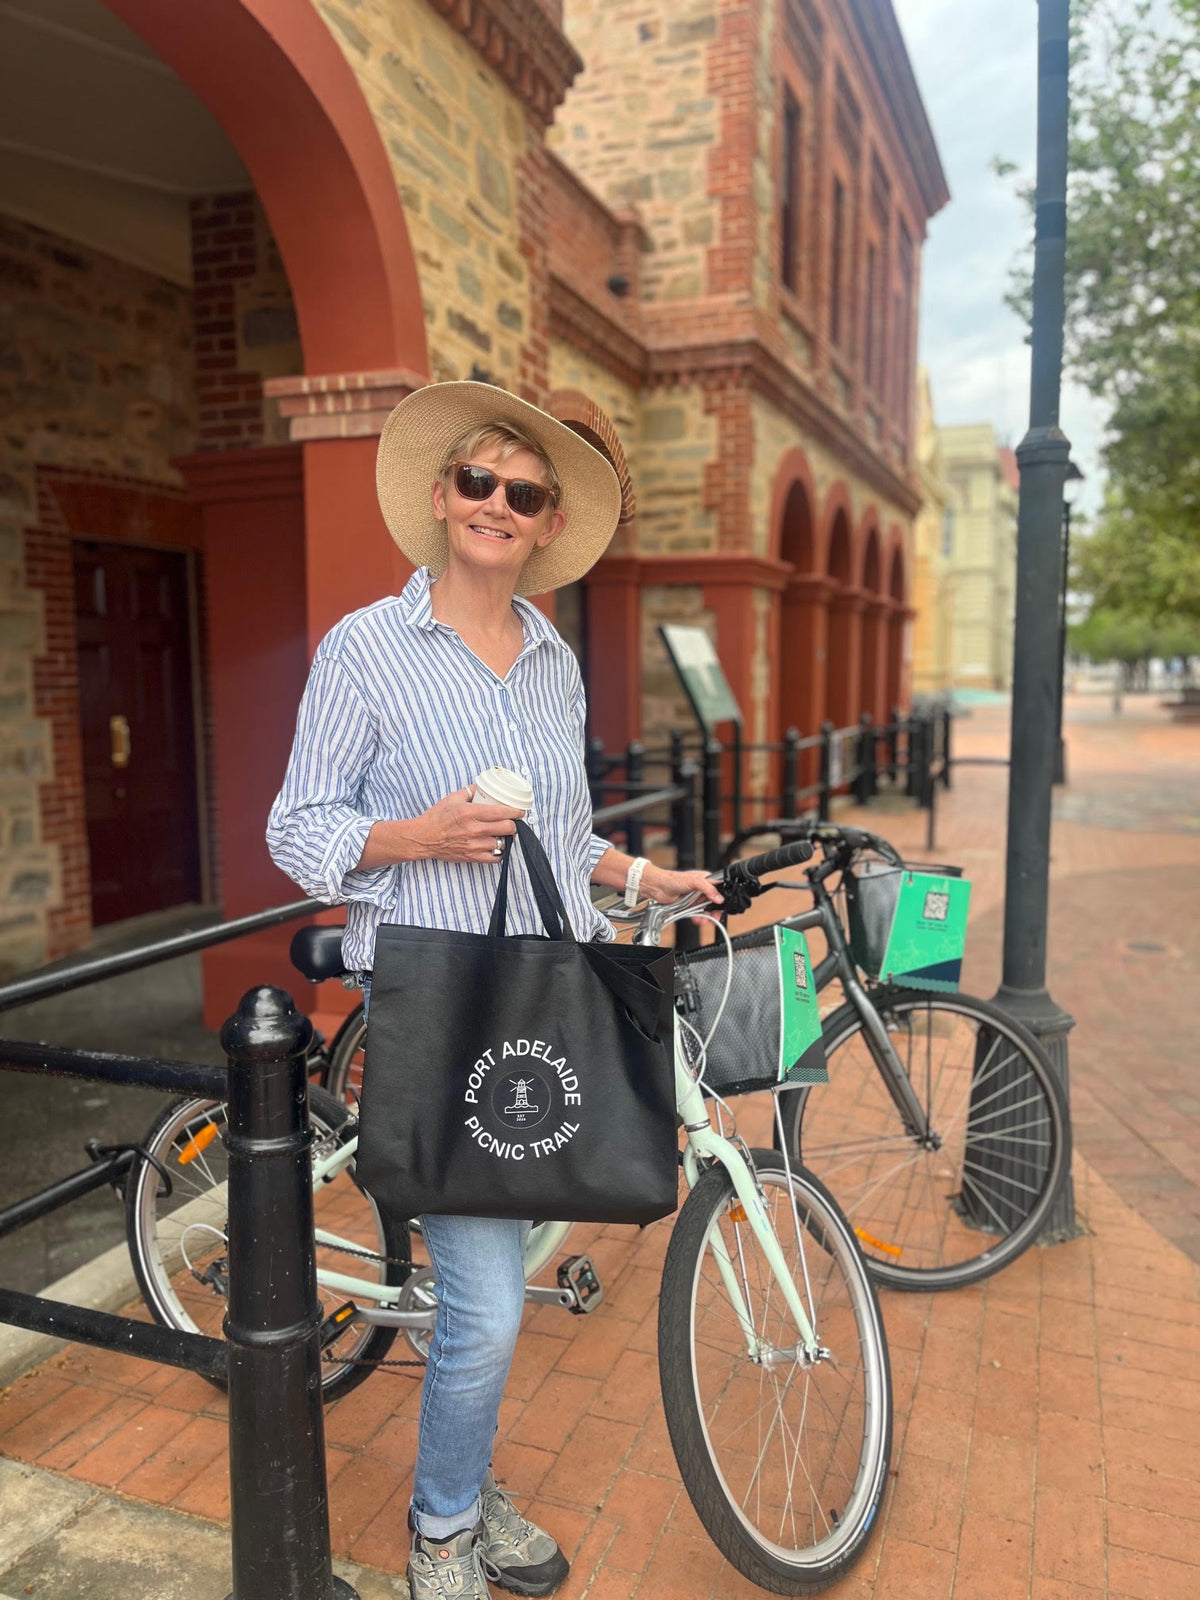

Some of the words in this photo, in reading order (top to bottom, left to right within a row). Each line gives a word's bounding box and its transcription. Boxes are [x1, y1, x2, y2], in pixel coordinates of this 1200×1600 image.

[465, 1049, 496, 1104] PORT
[503, 1039, 581, 1106] ADELAIDE
[465, 1115, 525, 1160] PICNIC
[530, 1121, 581, 1158] TRAIL
